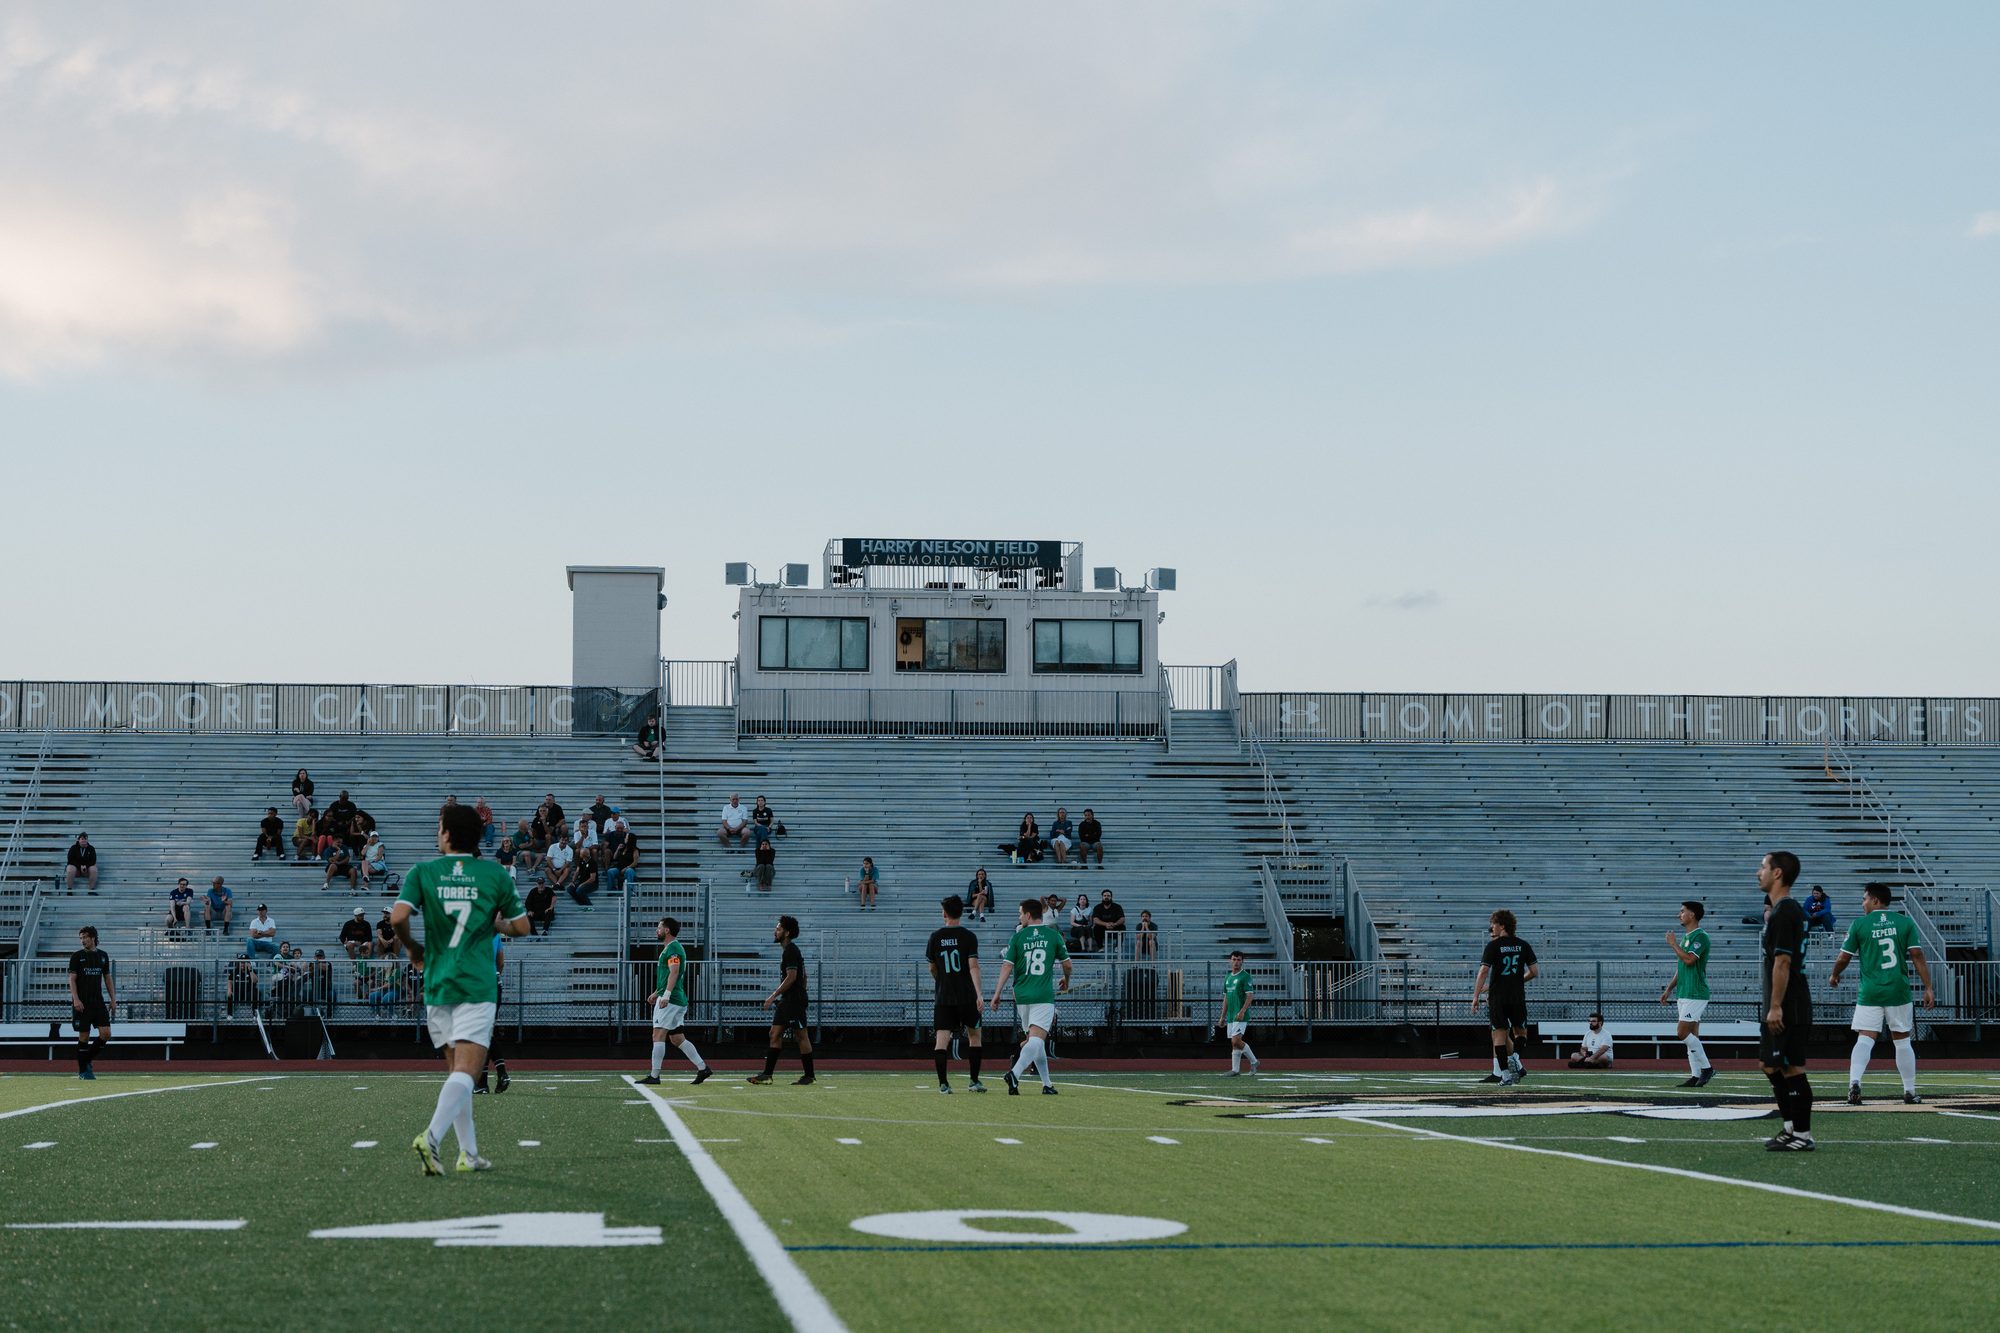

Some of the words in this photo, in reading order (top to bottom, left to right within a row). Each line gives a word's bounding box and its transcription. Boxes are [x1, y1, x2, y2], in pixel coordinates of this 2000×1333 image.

[861, 539, 917, 553] HARRY
[921, 540, 990, 554] NELSON
[994, 541, 1040, 555] FIELD
[861, 554, 878, 564] AT
[886, 555, 965, 566] MEMORIAL
[973, 556, 1039, 567] STADIUM
[84, 690, 273, 724] MOORE
[313, 692, 575, 726] CATHOLIC
[1362, 701, 1503, 733] HOME
[1541, 701, 1601, 733] OF
[1636, 702, 1723, 734] THE
[1761, 704, 1984, 737] HORNETS
[437, 886, 479, 900] TORRES
[443, 900, 472, 948] 7
[1871, 927, 1897, 938] ZEPEDA
[940, 949, 961, 974] 10
[1024, 948, 1047, 975] 18
[1501, 954, 1520, 975] 25
[1878, 938, 1897, 969] 3
